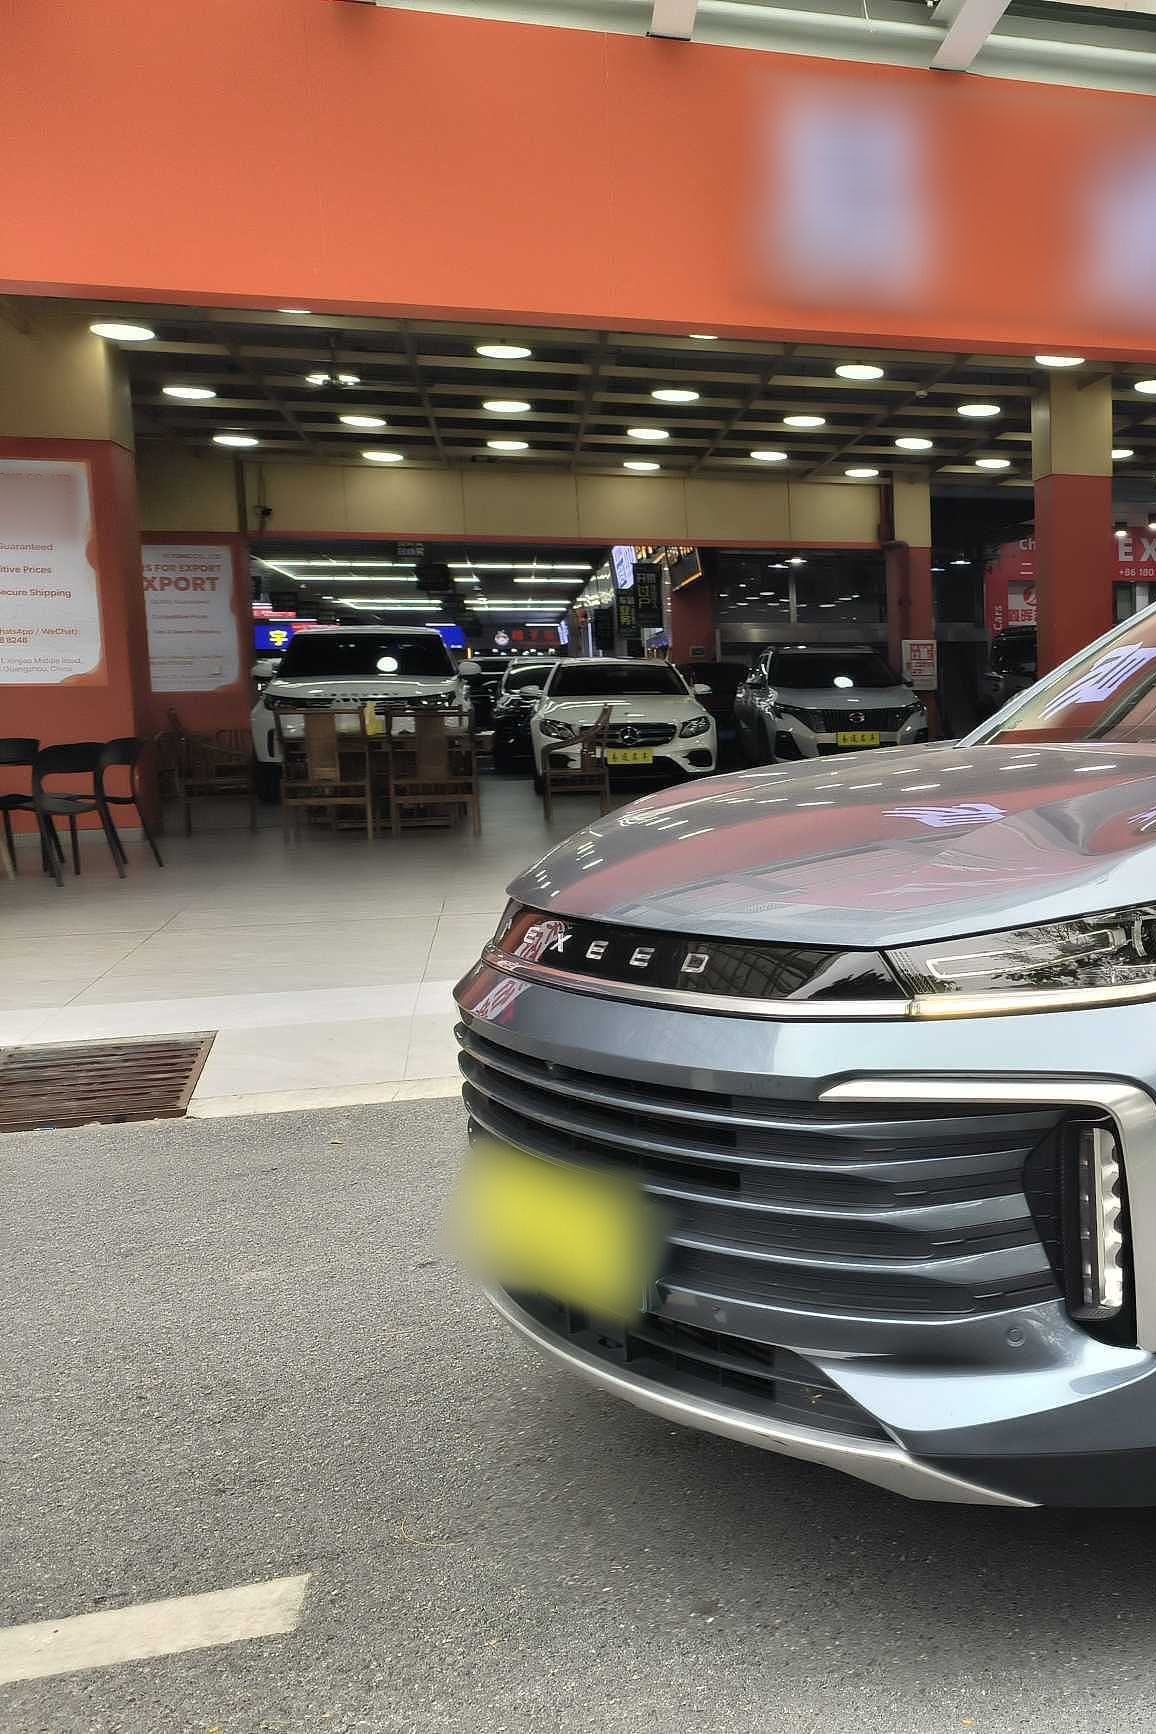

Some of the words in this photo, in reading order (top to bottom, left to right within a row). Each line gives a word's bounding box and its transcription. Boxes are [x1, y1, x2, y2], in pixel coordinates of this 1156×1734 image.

[23, 566, 52, 574] Prices
[30, 588, 72, 599] Shipping
[523, 926, 710, 974] EXEED
